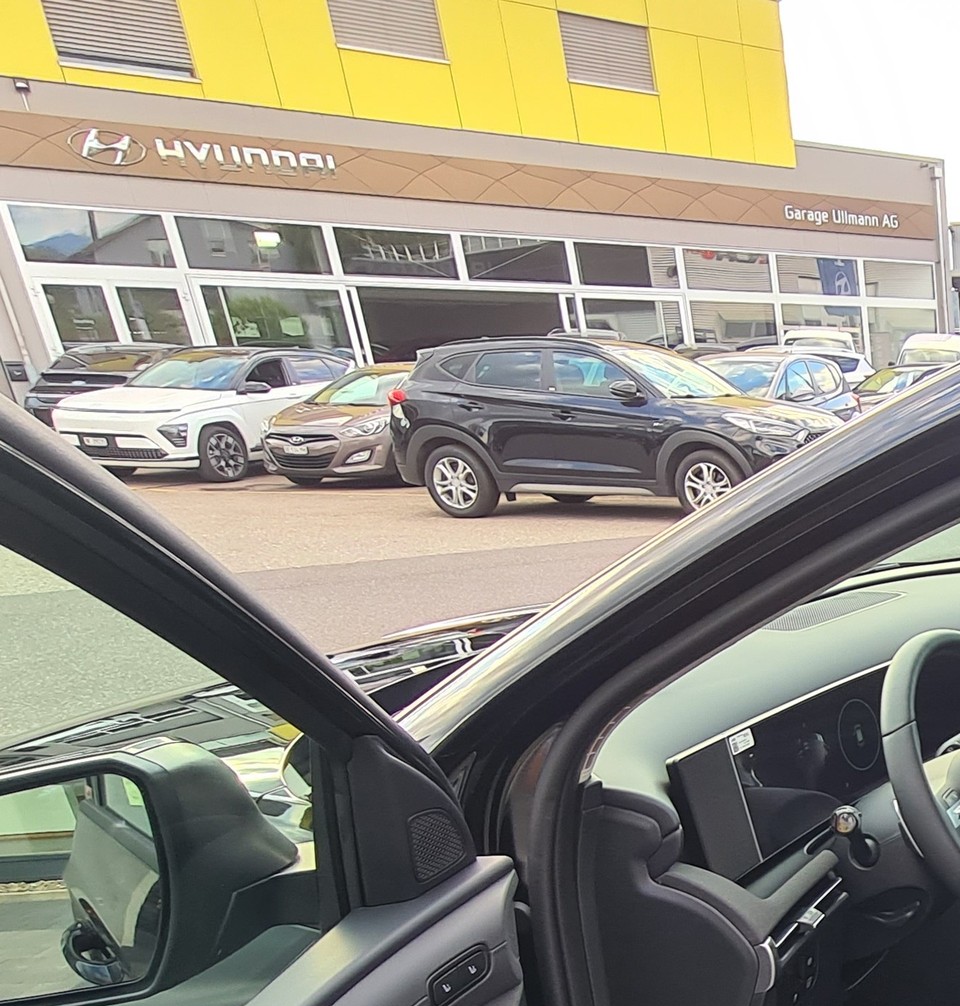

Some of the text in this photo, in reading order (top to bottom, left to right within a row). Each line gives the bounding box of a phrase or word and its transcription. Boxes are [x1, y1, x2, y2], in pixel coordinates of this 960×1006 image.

[154, 137, 336, 173] HYUNDAI
[784, 204, 899, 229] Garage Ullmann AG
